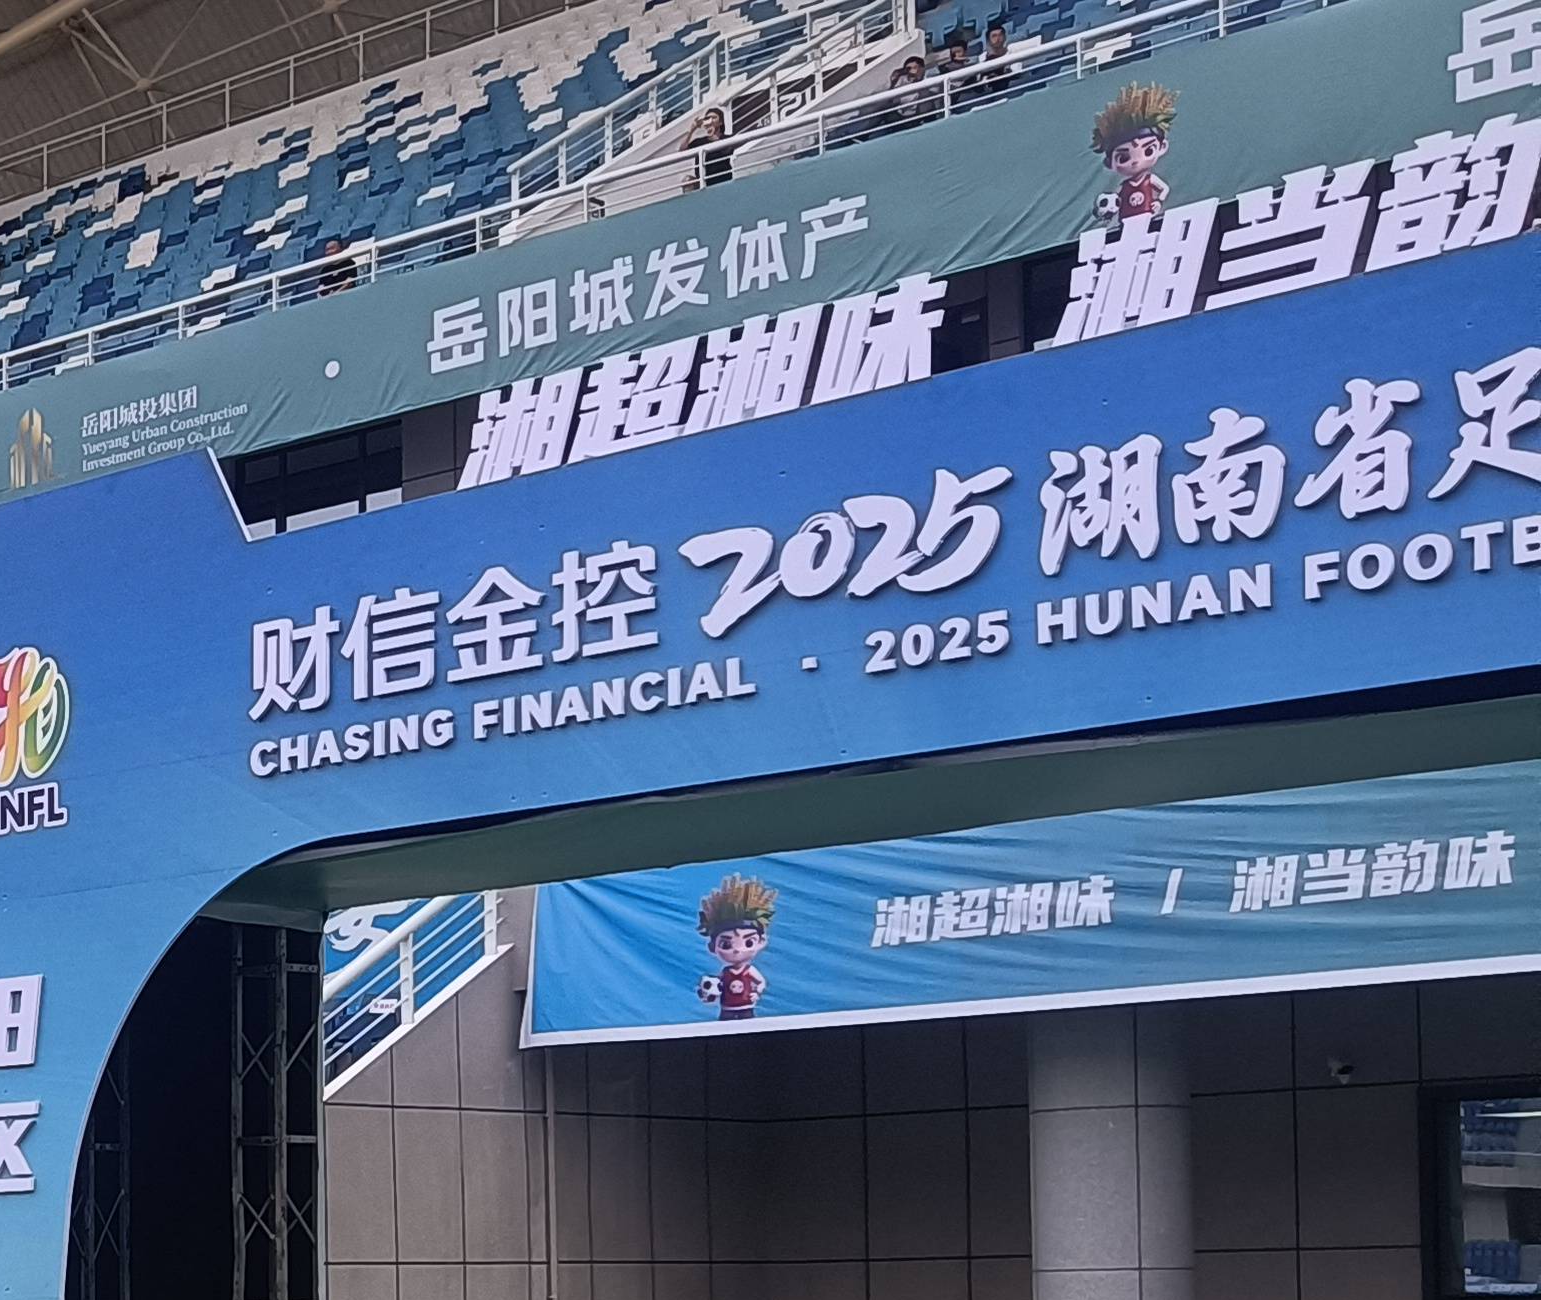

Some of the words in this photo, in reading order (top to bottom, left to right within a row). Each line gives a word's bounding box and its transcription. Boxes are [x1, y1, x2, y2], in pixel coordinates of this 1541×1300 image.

[426, 194, 870, 375] 岳阳城发体产
[81, 384, 198, 438] 岳阳城投集团
[81, 431, 130, 456] Yueyang
[131, 424, 168, 443] Urban
[169, 403, 248, 432] Construction
[82, 447, 146, 472] Investment
[147, 437, 185, 456] Group
[455, 272, 949, 491] 湘超湘味
[249, 540, 659, 721] 财信金控
[678, 466, 1013, 638] 2025
[1039, 347, 1541, 577] 湖南省足
[249, 708, 455, 777] CHASING
[473, 656, 758, 741] FINANCIAL
[864, 610, 1010, 673] 2025
[1036, 563, 1272, 645] HUNAN
[870, 874, 1116, 948] 湘超湘味
[1228, 830, 1517, 914] 湘当韵味
